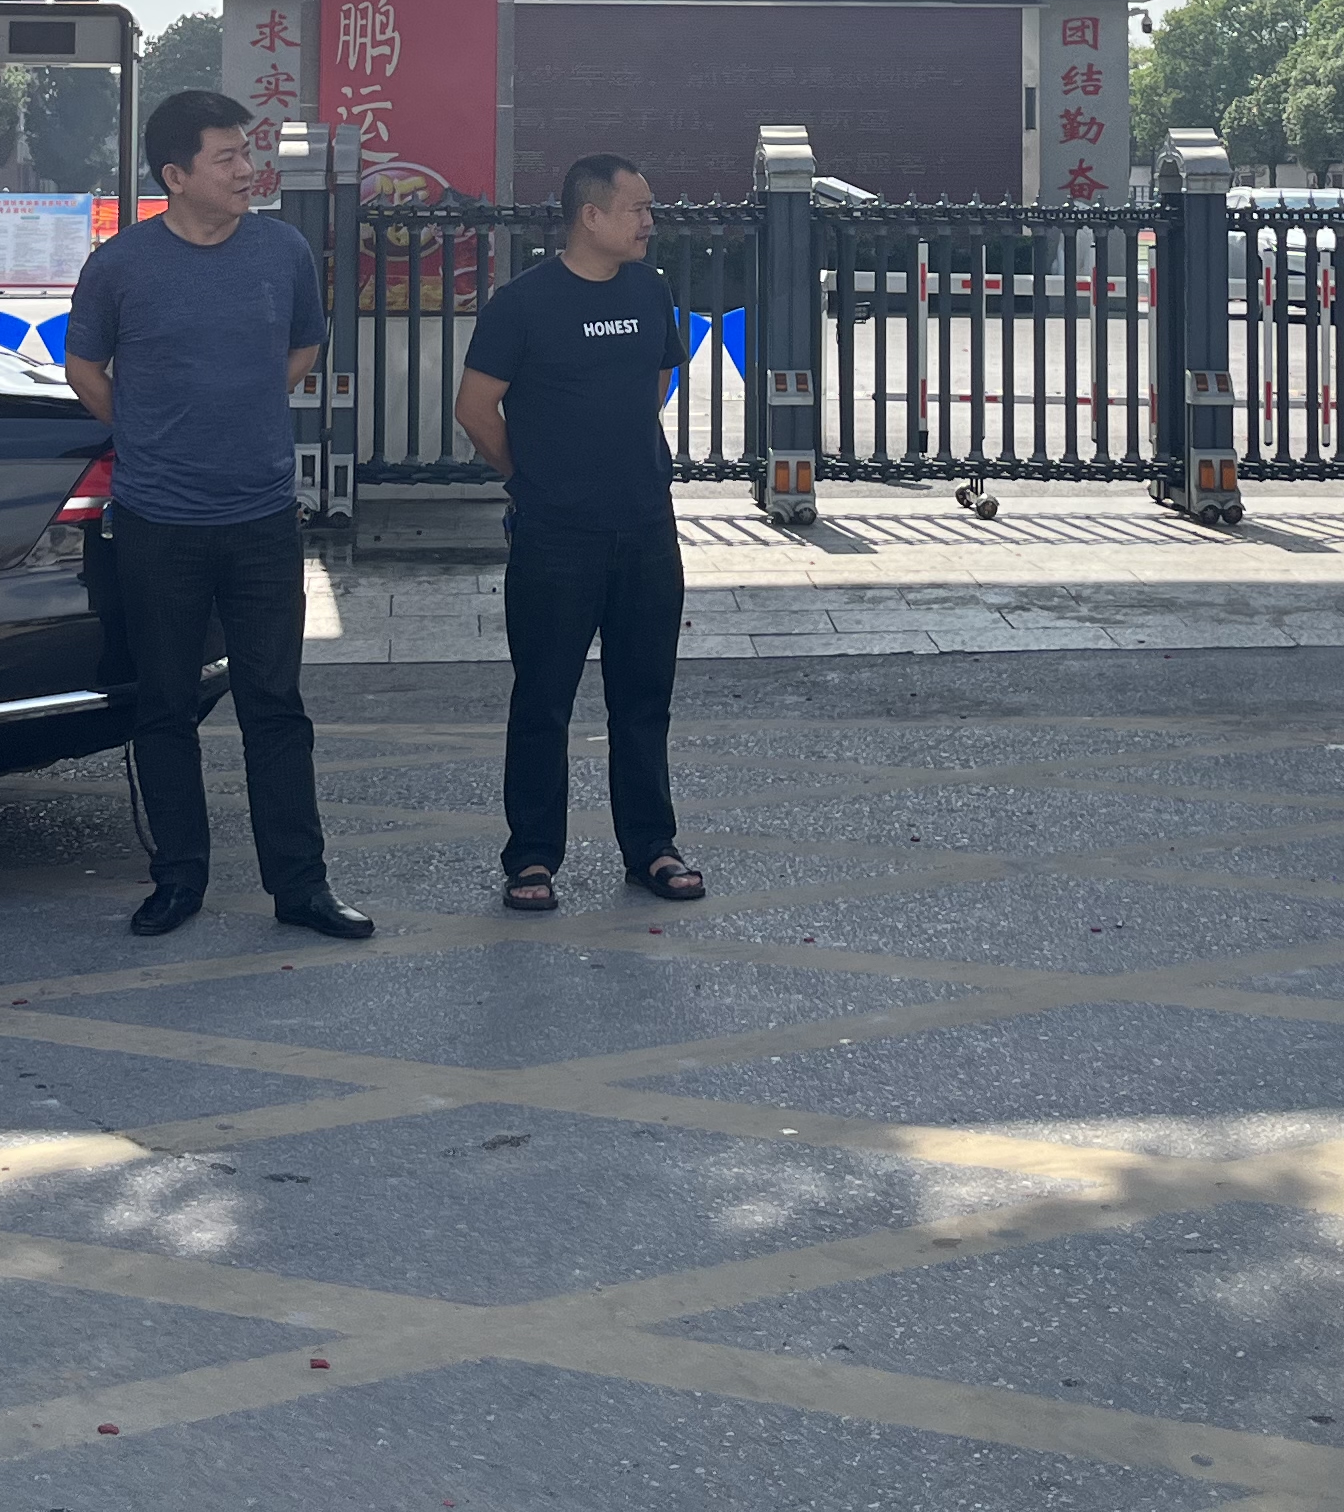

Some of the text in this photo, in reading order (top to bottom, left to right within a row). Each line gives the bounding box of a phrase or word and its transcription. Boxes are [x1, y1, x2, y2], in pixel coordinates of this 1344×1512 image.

[1058, 16, 1110, 201] 团结勤奋
[583, 319, 639, 337] HONEST
